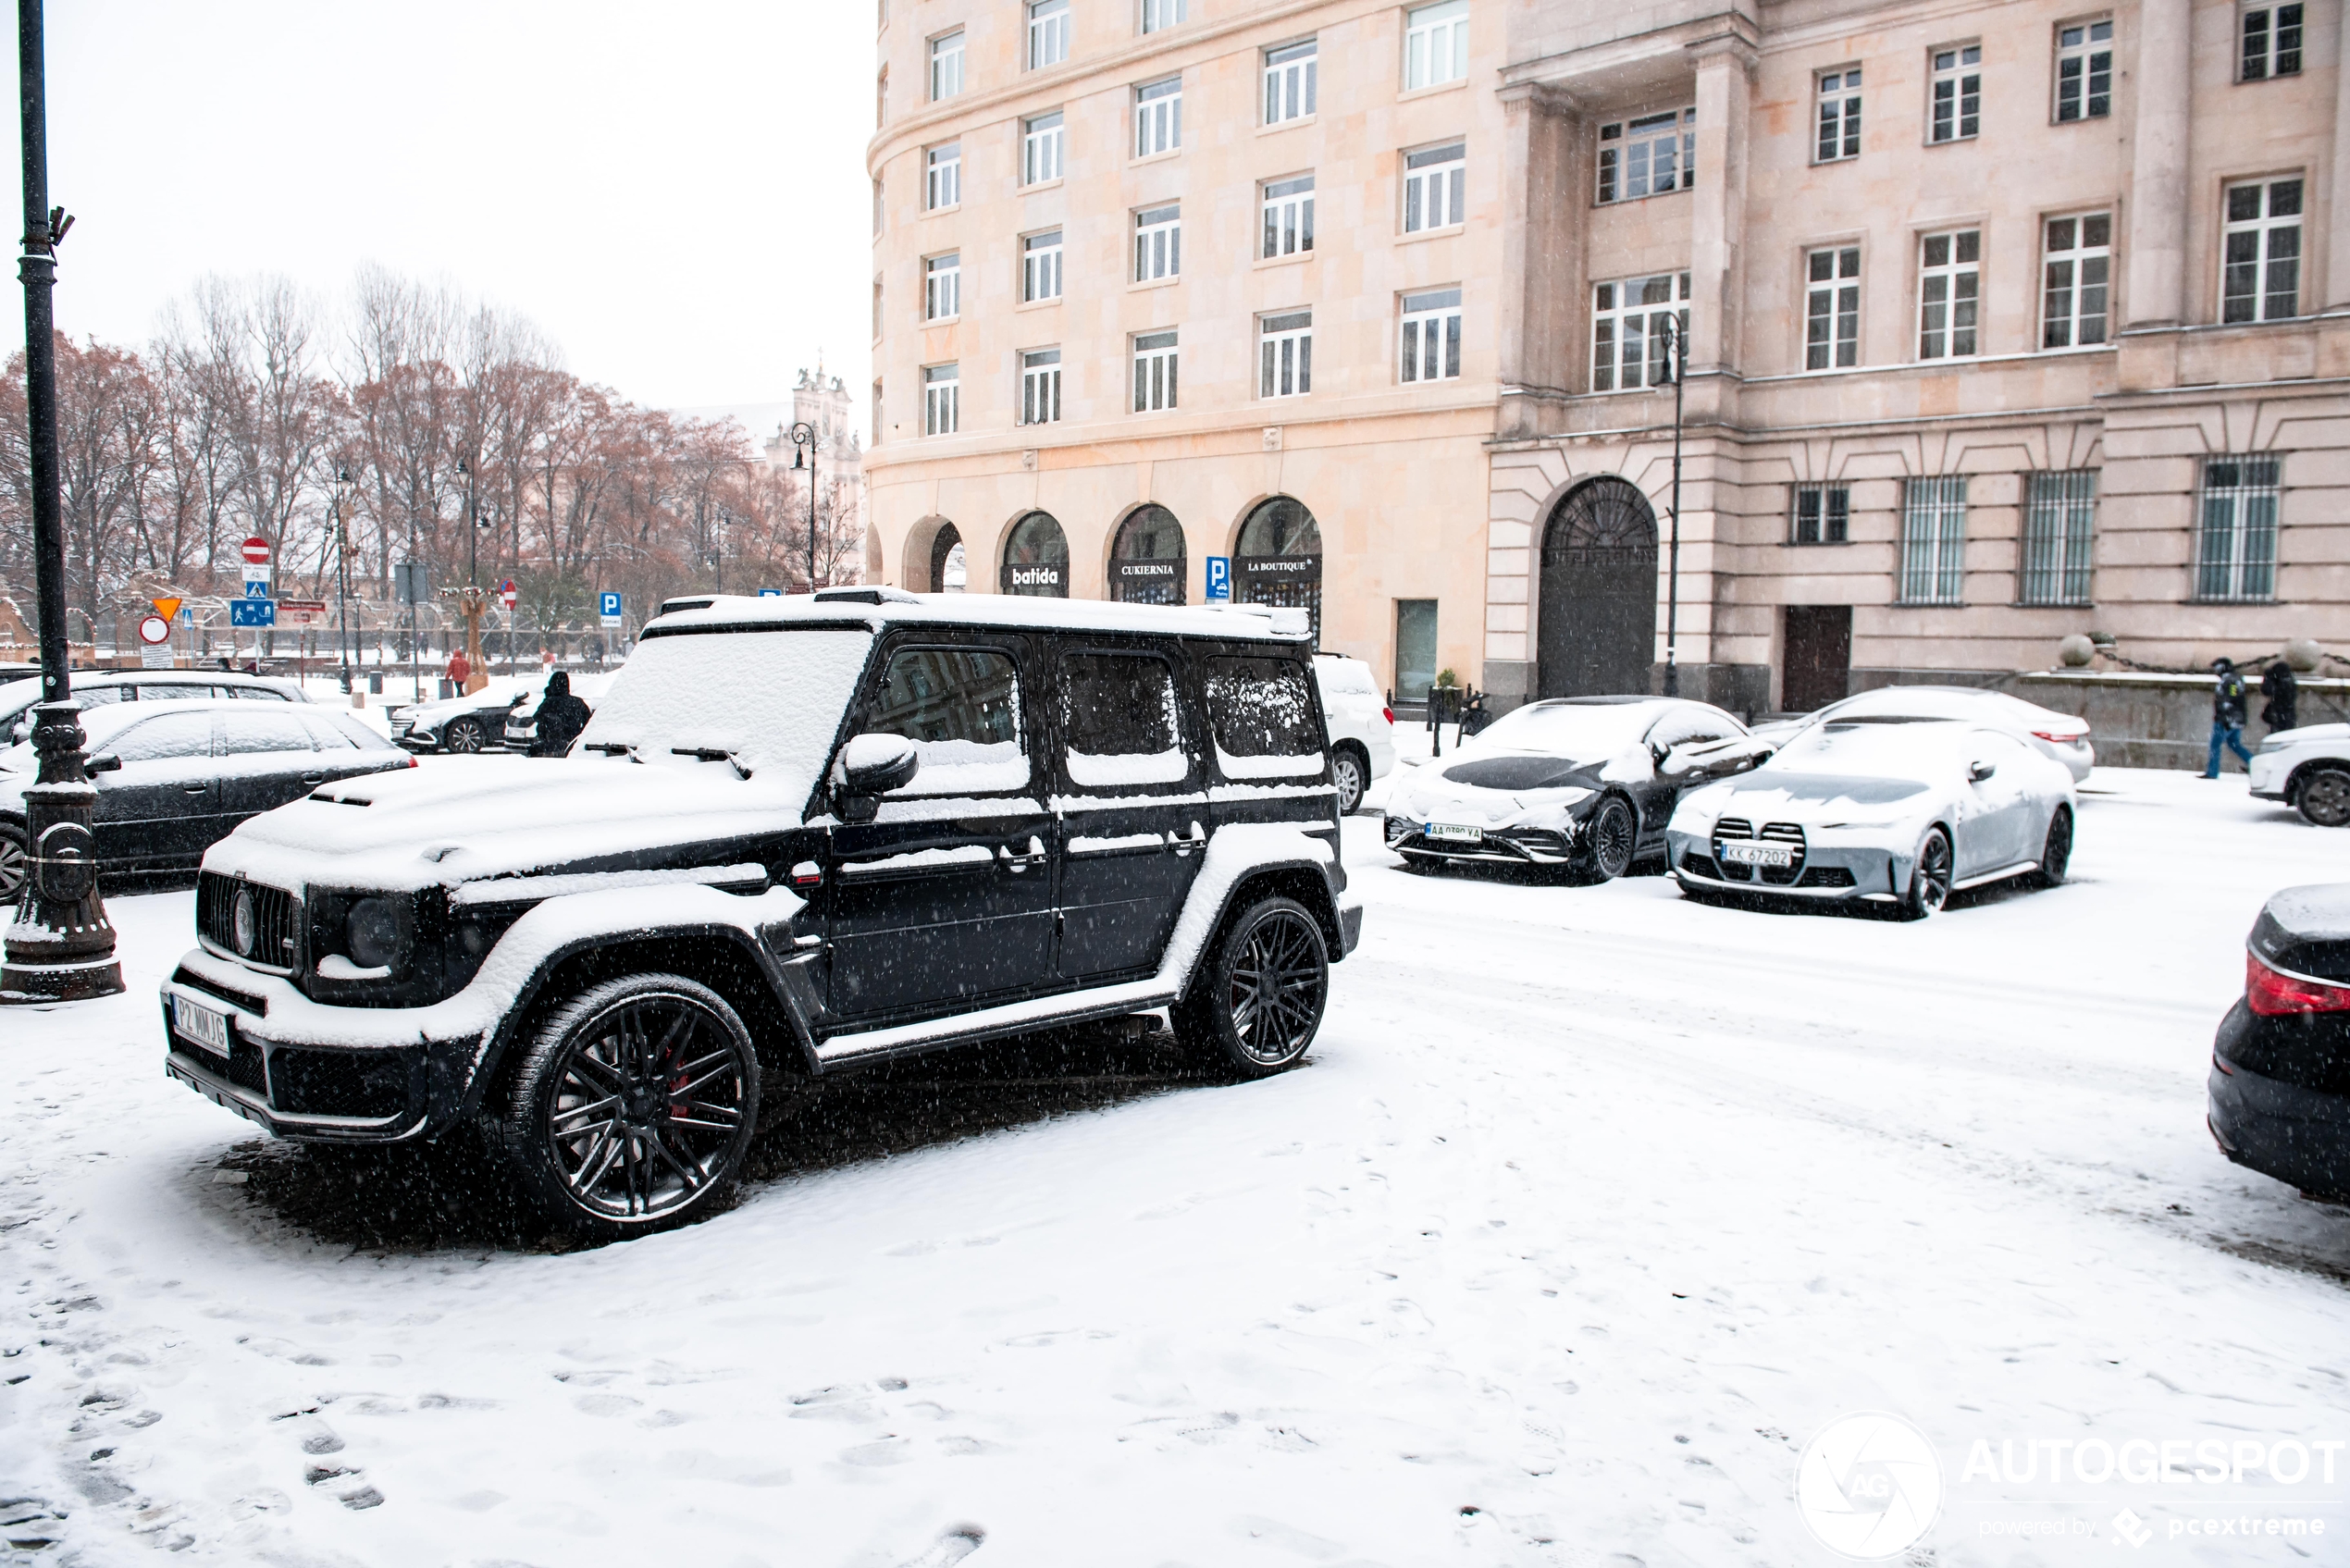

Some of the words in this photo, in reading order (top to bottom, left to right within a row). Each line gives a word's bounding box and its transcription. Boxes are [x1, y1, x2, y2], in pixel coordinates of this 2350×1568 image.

[1012, 567, 1058, 585] batida
[1121, 564, 1174, 575] CUKIERNIA
[1211, 560, 1225, 586] P
[1248, 562, 1259, 572] LA
[1260, 562, 1306, 573] BOUTIQUE
[604, 595, 617, 613] P
[1431, 825, 1443, 835] AA
[1728, 846, 1744, 860] KK
[1749, 849, 1787, 864] 67202
[179, 999, 192, 1031] P2
